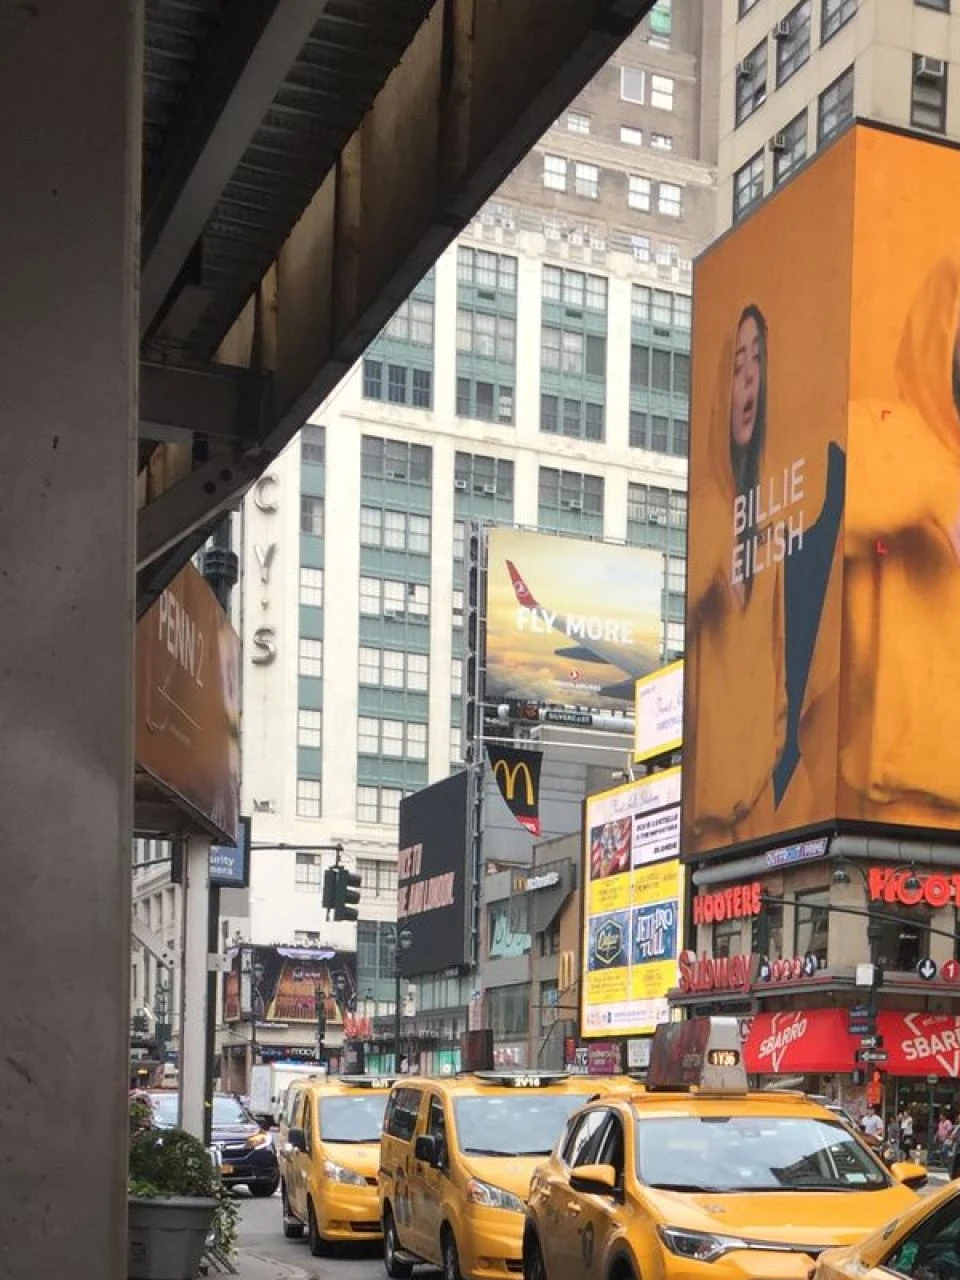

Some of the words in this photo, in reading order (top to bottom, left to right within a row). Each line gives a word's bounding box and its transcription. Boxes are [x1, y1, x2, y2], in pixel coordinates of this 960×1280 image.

[733, 458, 806, 537] BILLIE
[731, 510, 804, 585] EILISH
[158, 588, 196, 677] PENN
[515, 607, 558, 634] FLY
[565, 613, 633, 644] MORE
[693, 882, 762, 926] HOOTERS
[678, 949, 750, 993] Subway
[947, 965, 955, 978] 1
[757, 1018, 808, 1059] SBARRO
